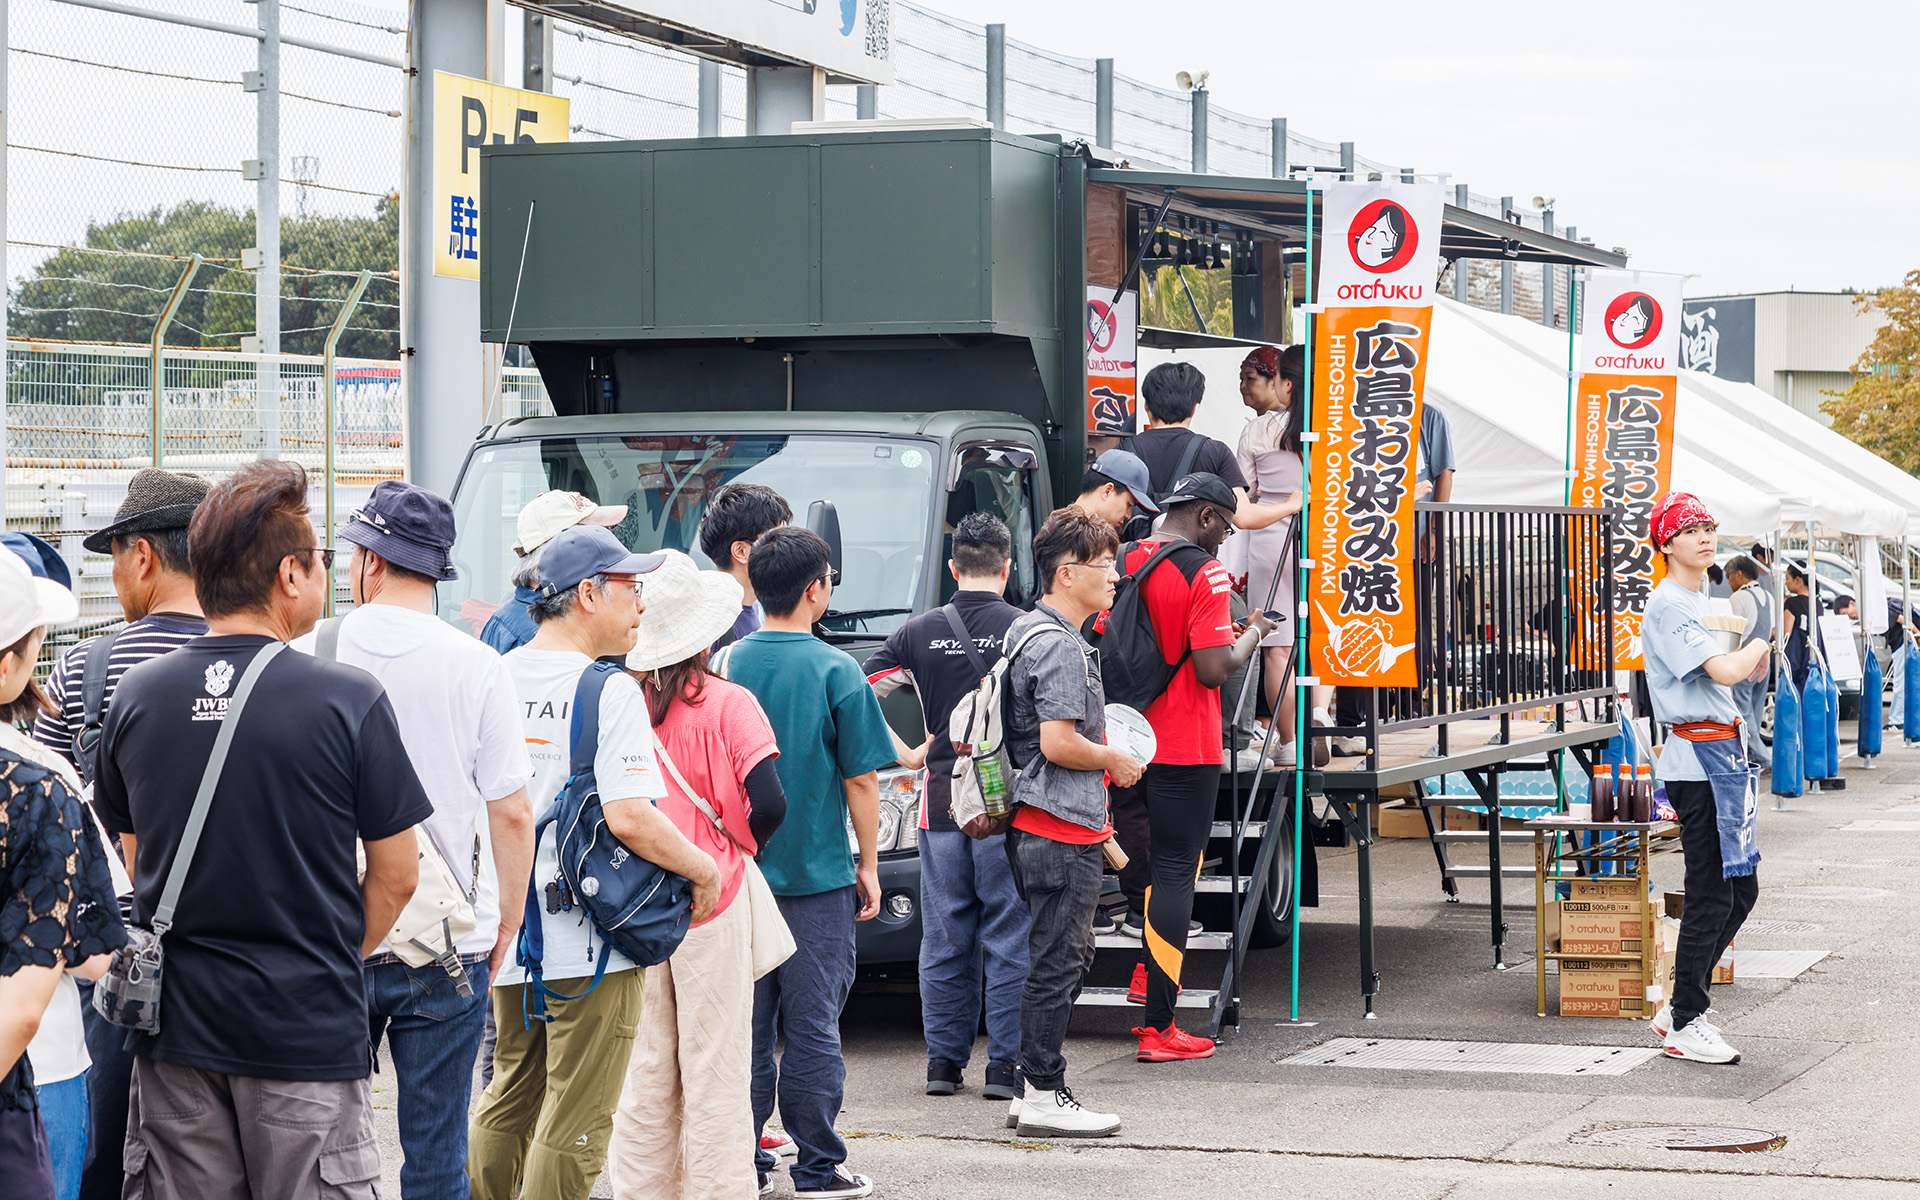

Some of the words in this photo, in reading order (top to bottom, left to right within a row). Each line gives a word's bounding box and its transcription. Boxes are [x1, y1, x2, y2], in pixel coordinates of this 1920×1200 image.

[1326, 334, 1347, 447] HIROSHIMA
[1583, 394, 1601, 483] HIROSHIMA
[1320, 450, 1343, 594] OKONOMIYAKI
[1339, 320, 1423, 617] 広島お好み焼
[1565, 903, 1590, 911] 100113
